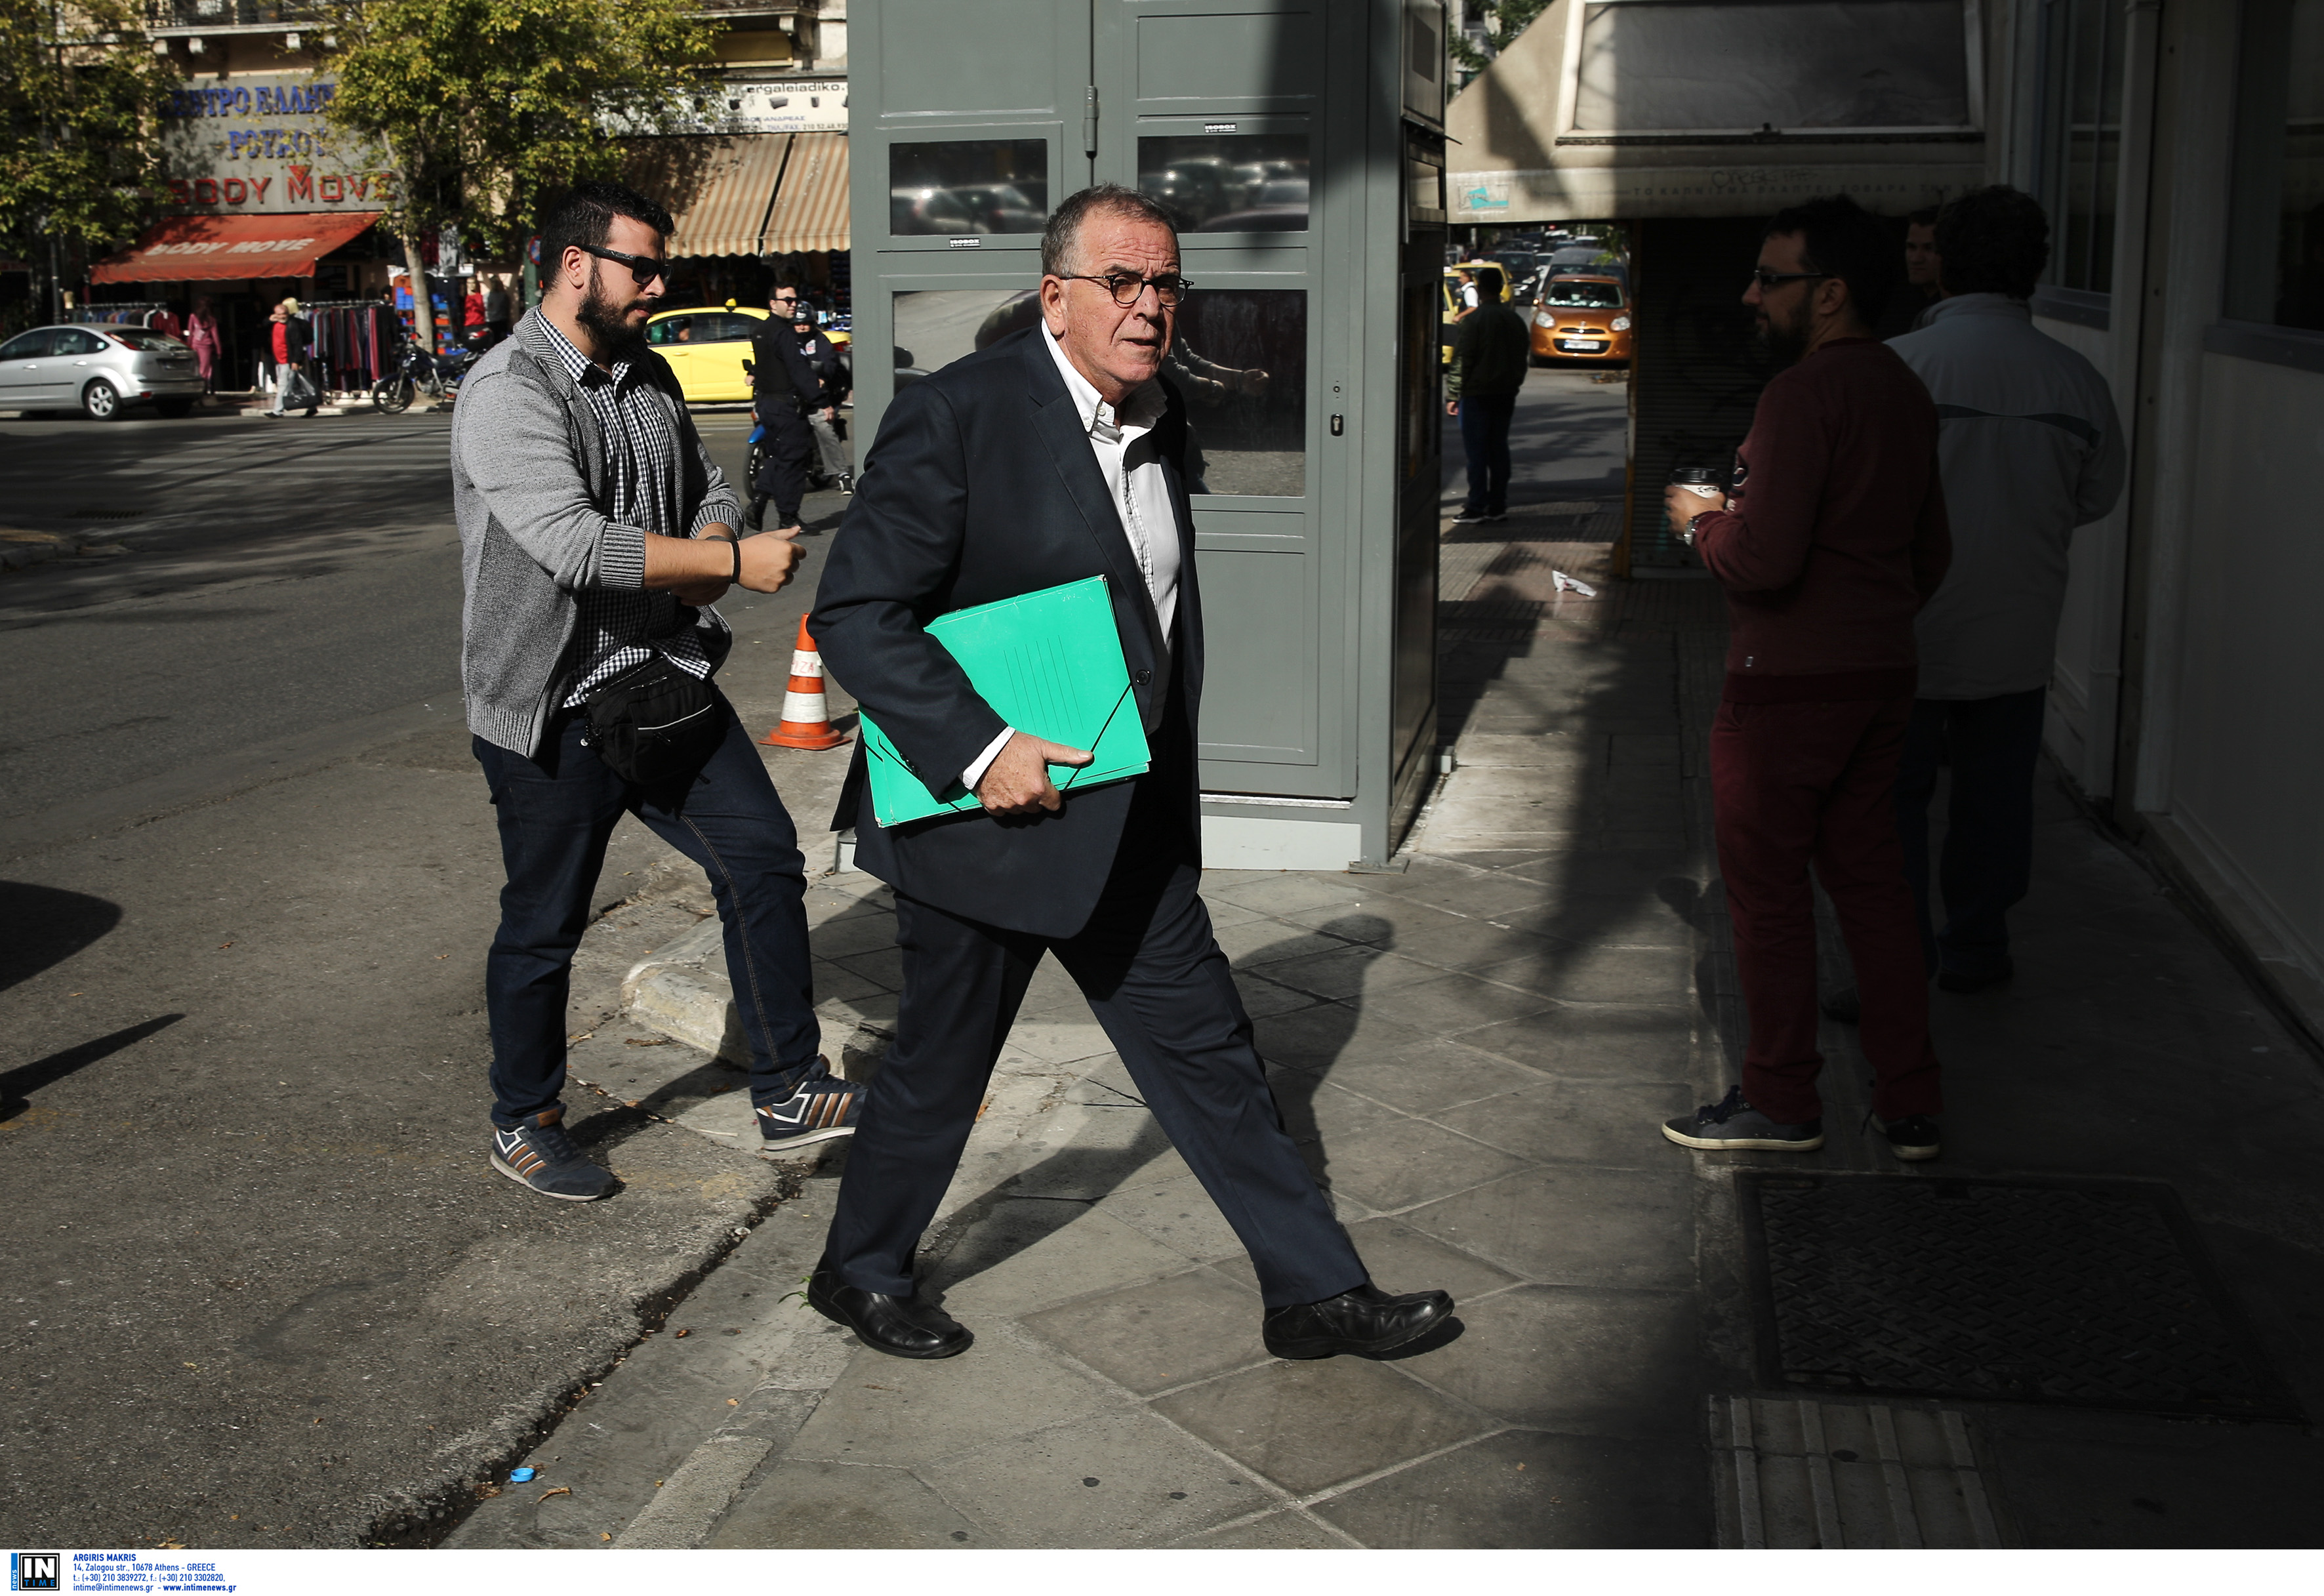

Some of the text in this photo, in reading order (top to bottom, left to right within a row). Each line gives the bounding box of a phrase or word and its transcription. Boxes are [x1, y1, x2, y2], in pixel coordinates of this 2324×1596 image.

[287, 174, 396, 203] MOVE
[144, 238, 316, 256] BODY MOVE
